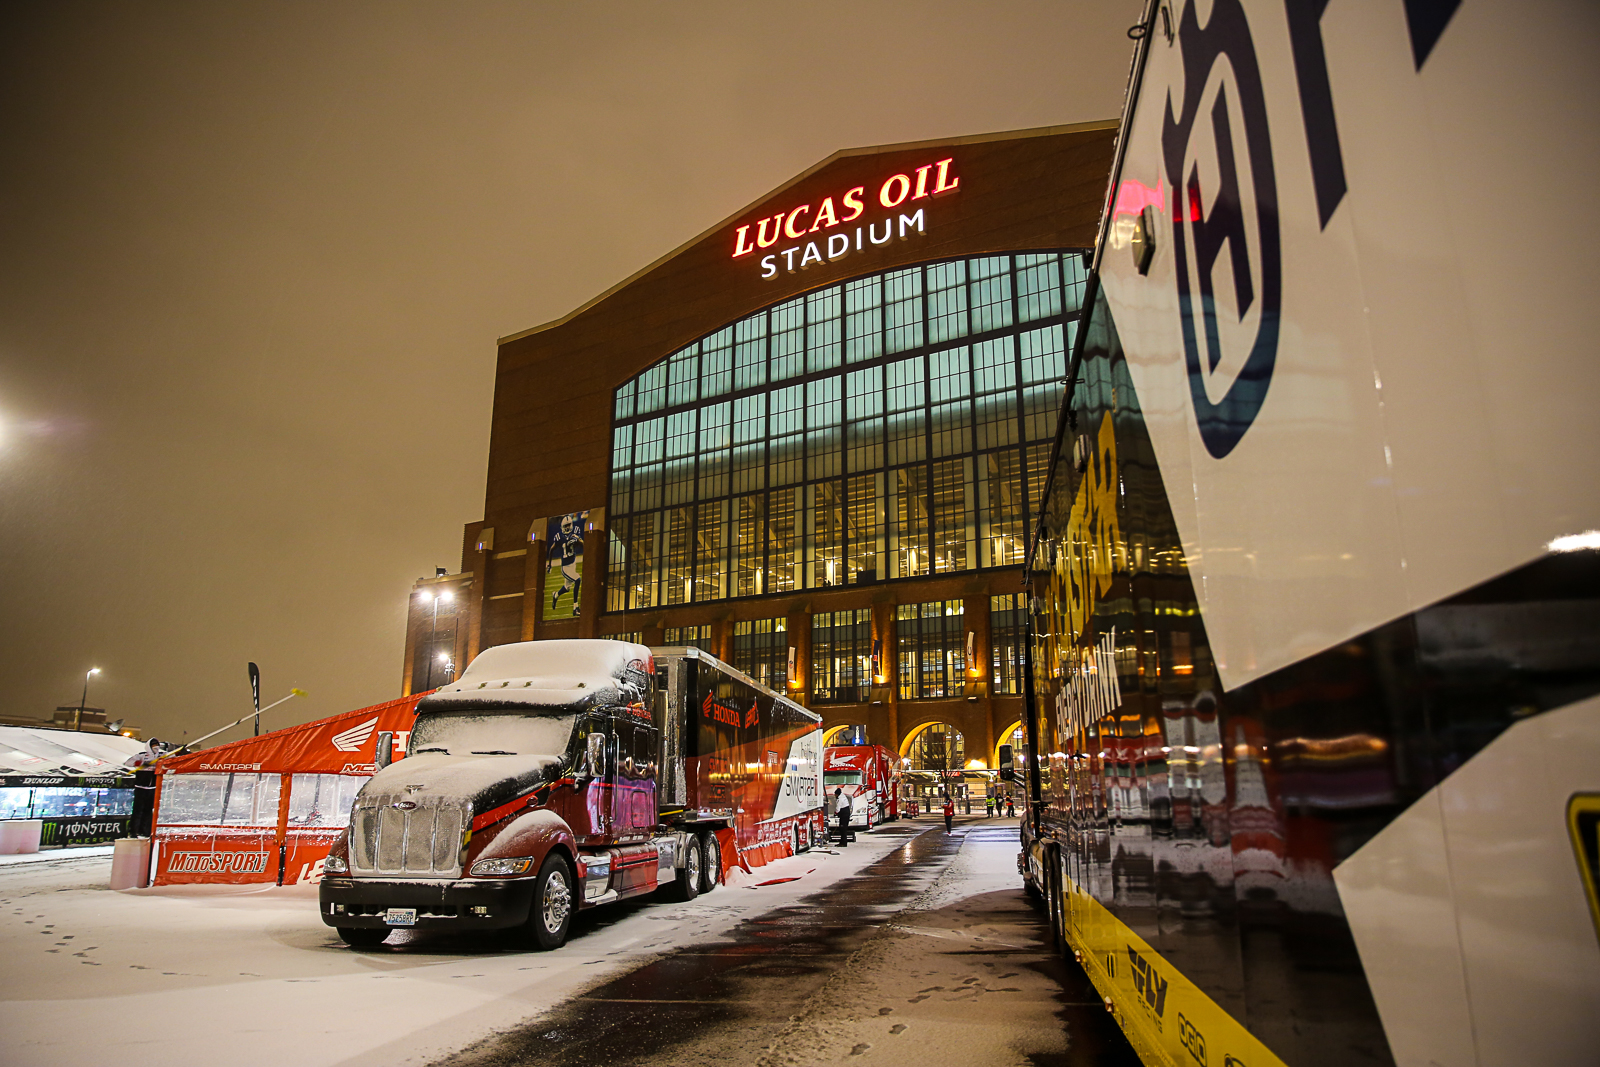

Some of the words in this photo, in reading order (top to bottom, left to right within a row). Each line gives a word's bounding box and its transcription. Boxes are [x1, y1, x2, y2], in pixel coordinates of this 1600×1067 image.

[732, 186, 864, 258] LUCAS
[878, 157, 960, 208] OIL
[760, 208, 925, 279] STADIUM
[1081, 625, 1122, 728] DRINK
[713, 703, 741, 728] HONDA
[22, 777, 65, 785] DUNLOP
[85, 777, 115, 785] MONSTER
[59, 821, 121, 838] MONSTER
[68, 837, 112, 845] ENERGY
[1127, 943, 1168, 1018] FLY
[1137, 994, 1163, 1034] RACING
